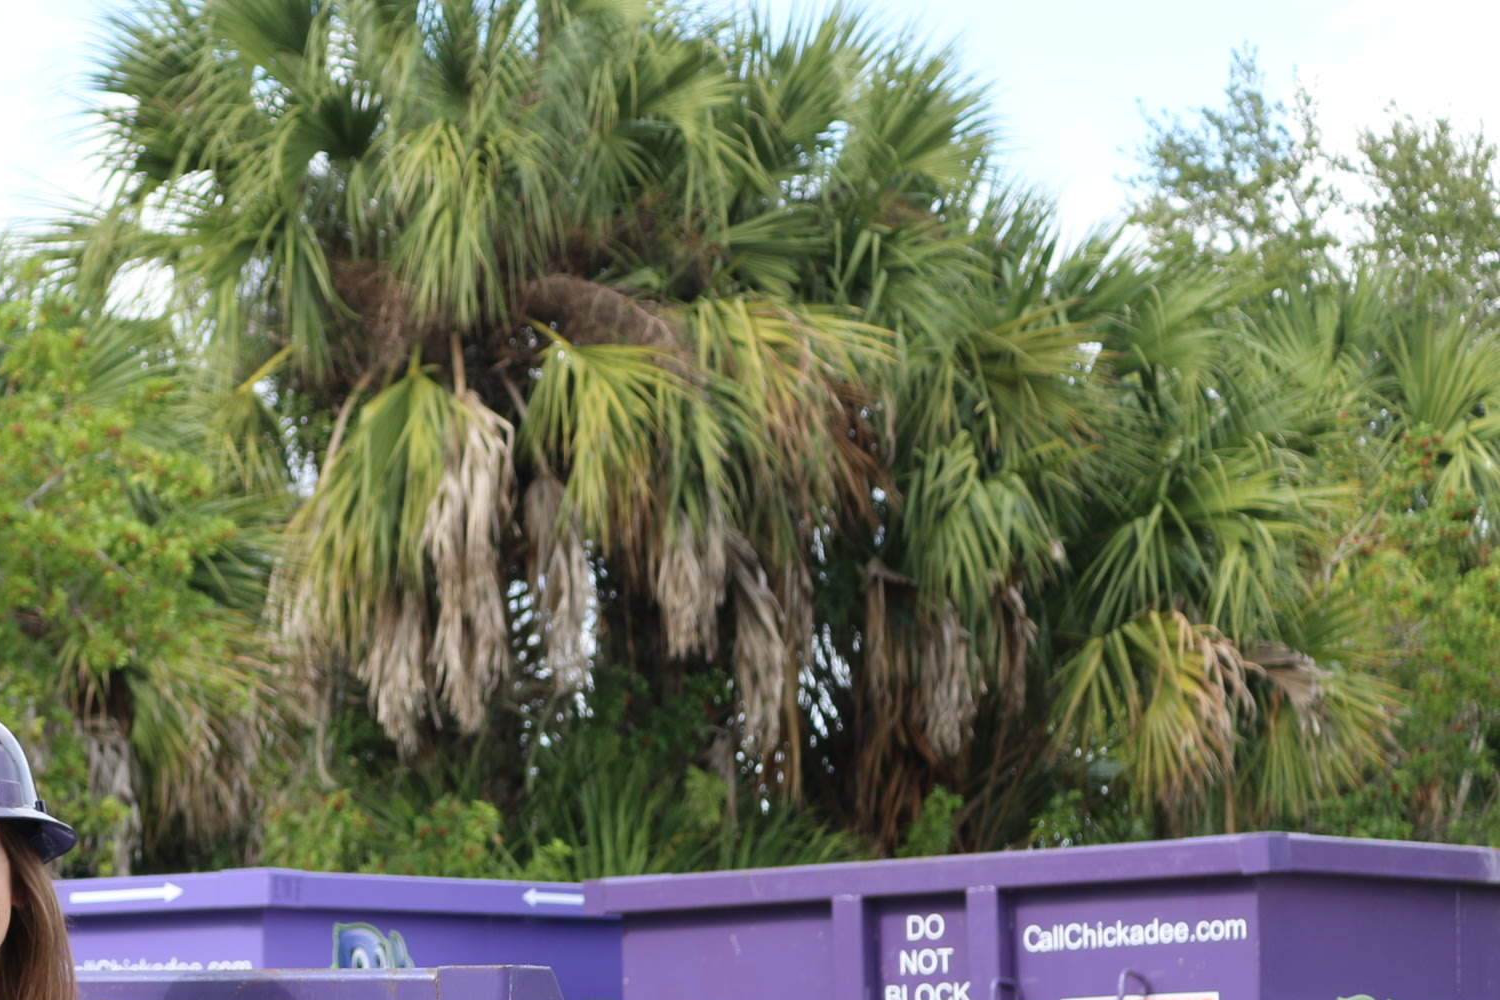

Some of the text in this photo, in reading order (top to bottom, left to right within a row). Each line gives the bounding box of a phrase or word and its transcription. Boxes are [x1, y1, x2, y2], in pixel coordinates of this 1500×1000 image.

[906, 913, 945, 941] DO
[1023, 917, 1247, 953] CallChickadee.com
[900, 947, 954, 976] NOT
